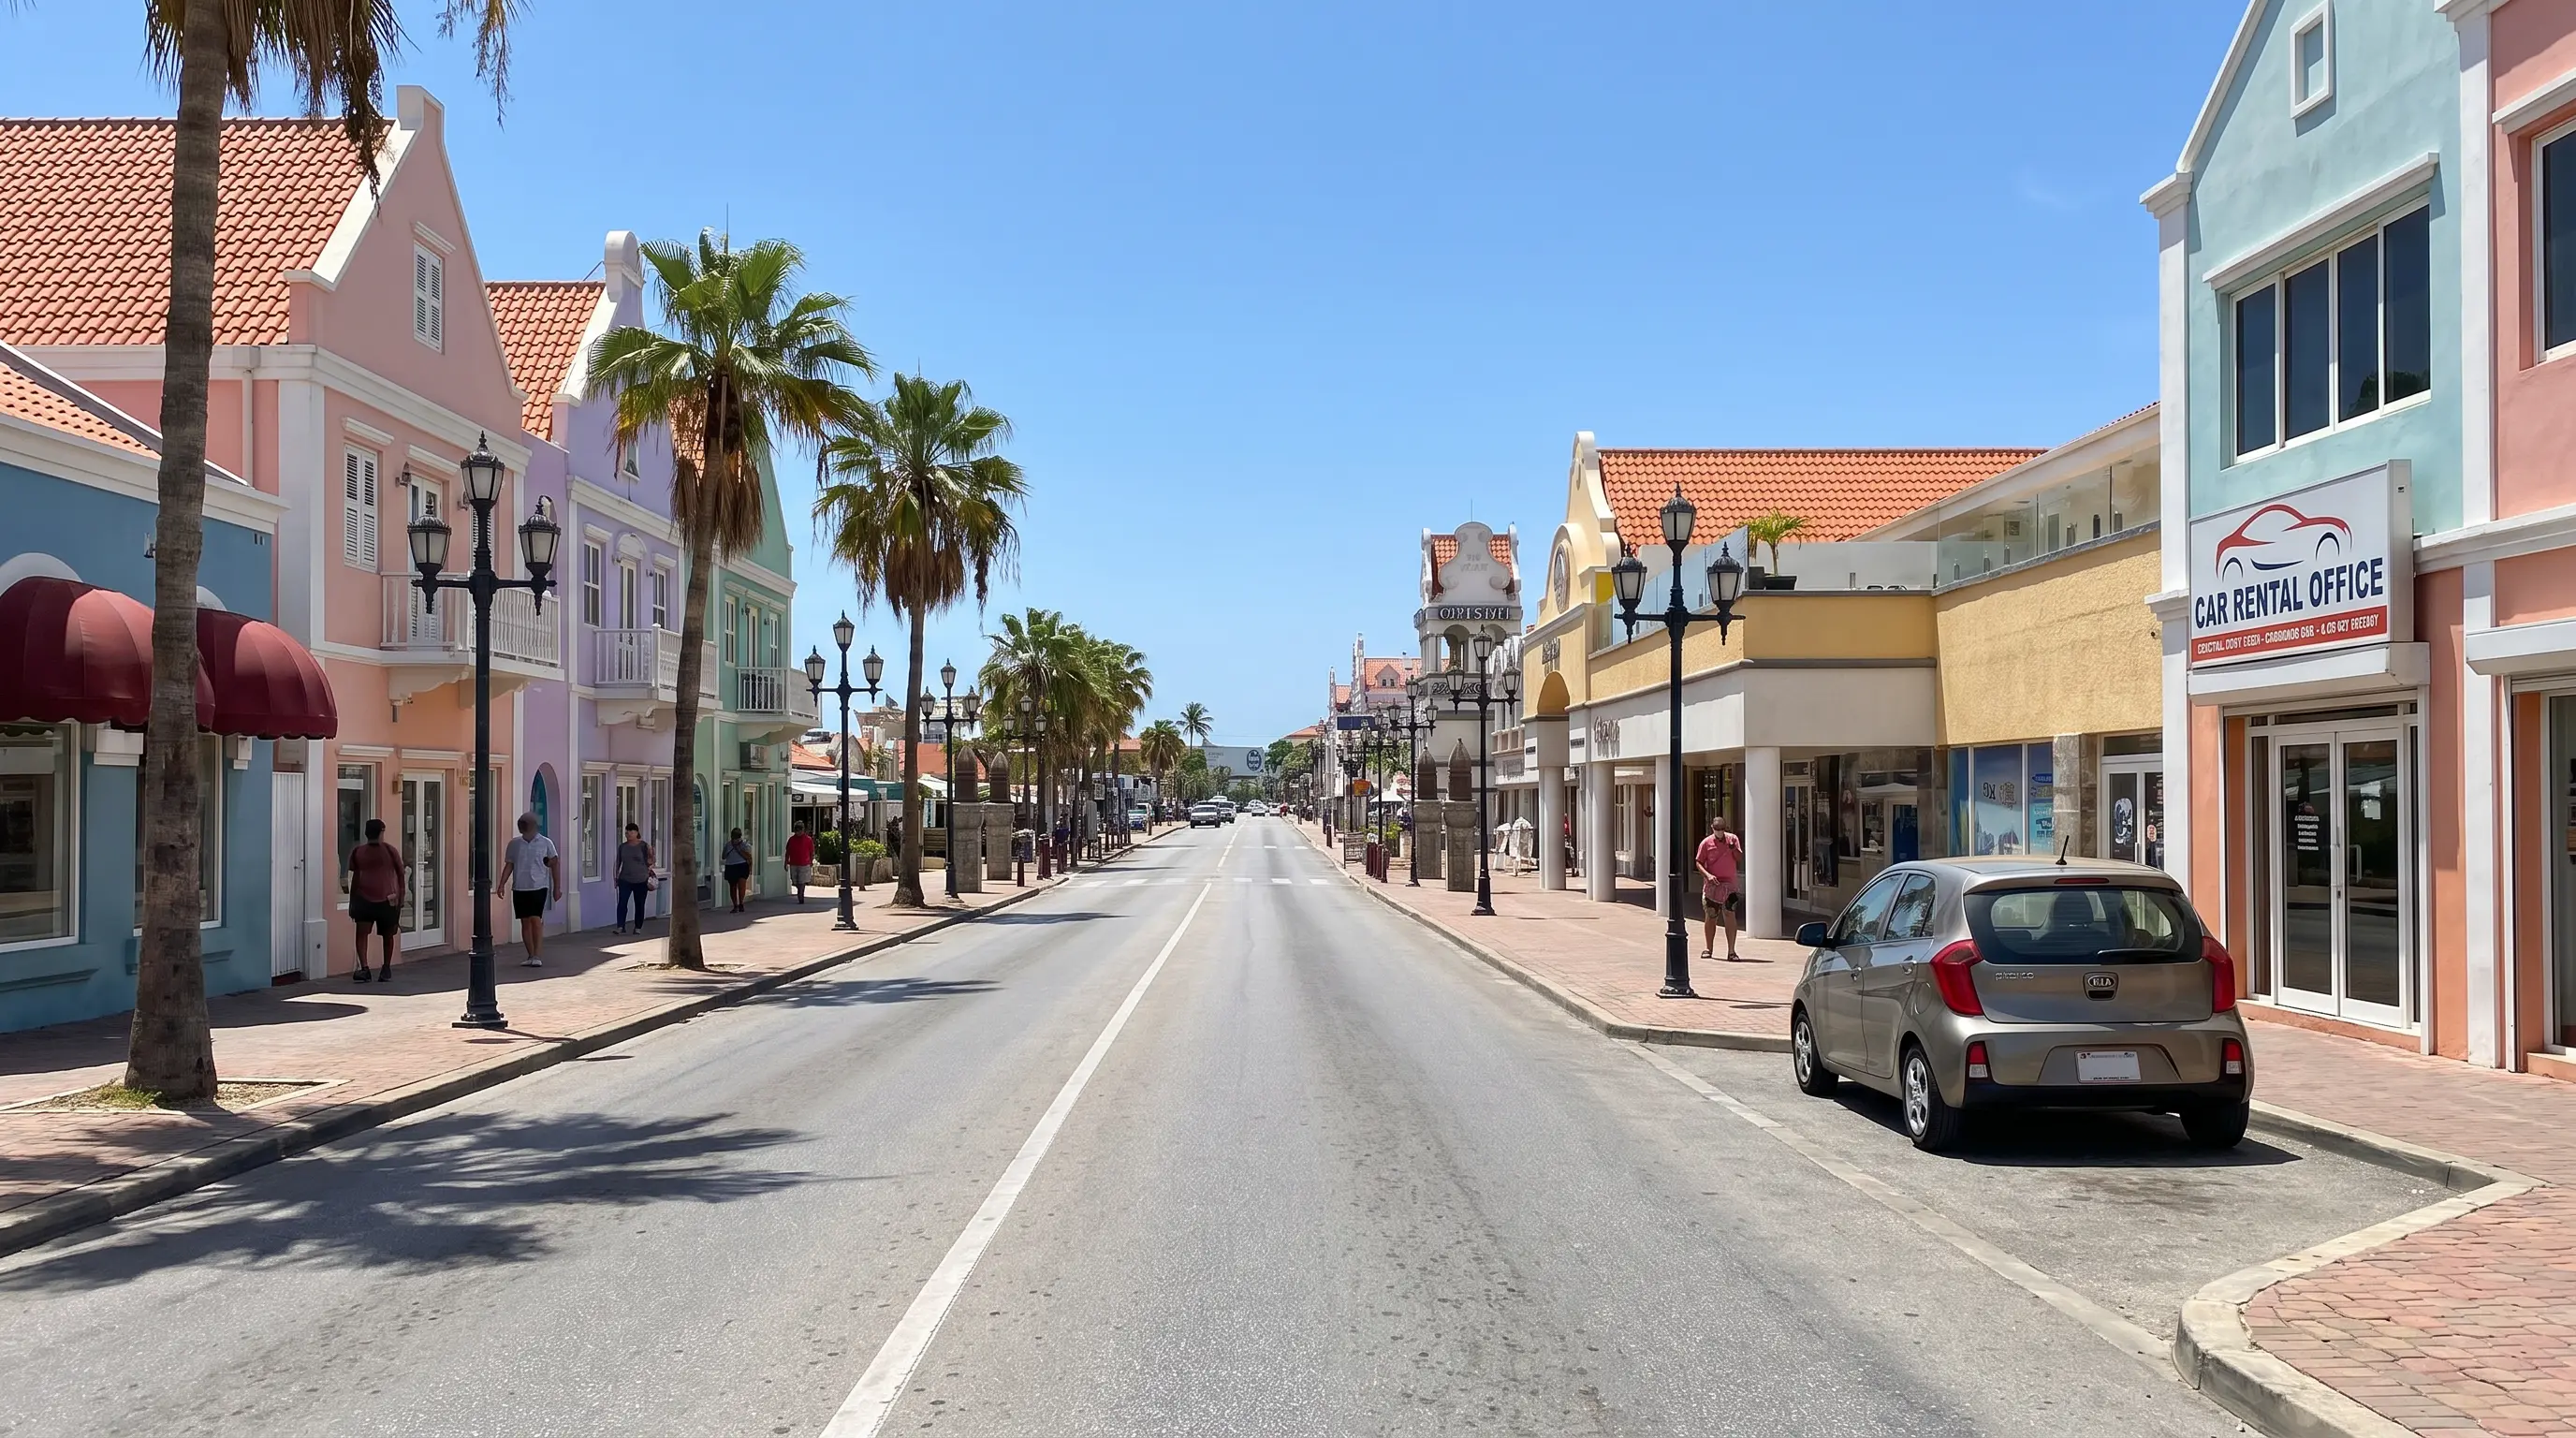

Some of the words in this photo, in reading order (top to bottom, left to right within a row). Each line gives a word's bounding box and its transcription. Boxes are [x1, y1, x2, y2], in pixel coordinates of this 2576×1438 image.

[2195, 592, 2229, 629] CAR
[2233, 576, 2303, 623] RENTAL
[2309, 557, 2384, 608] OFFICE
